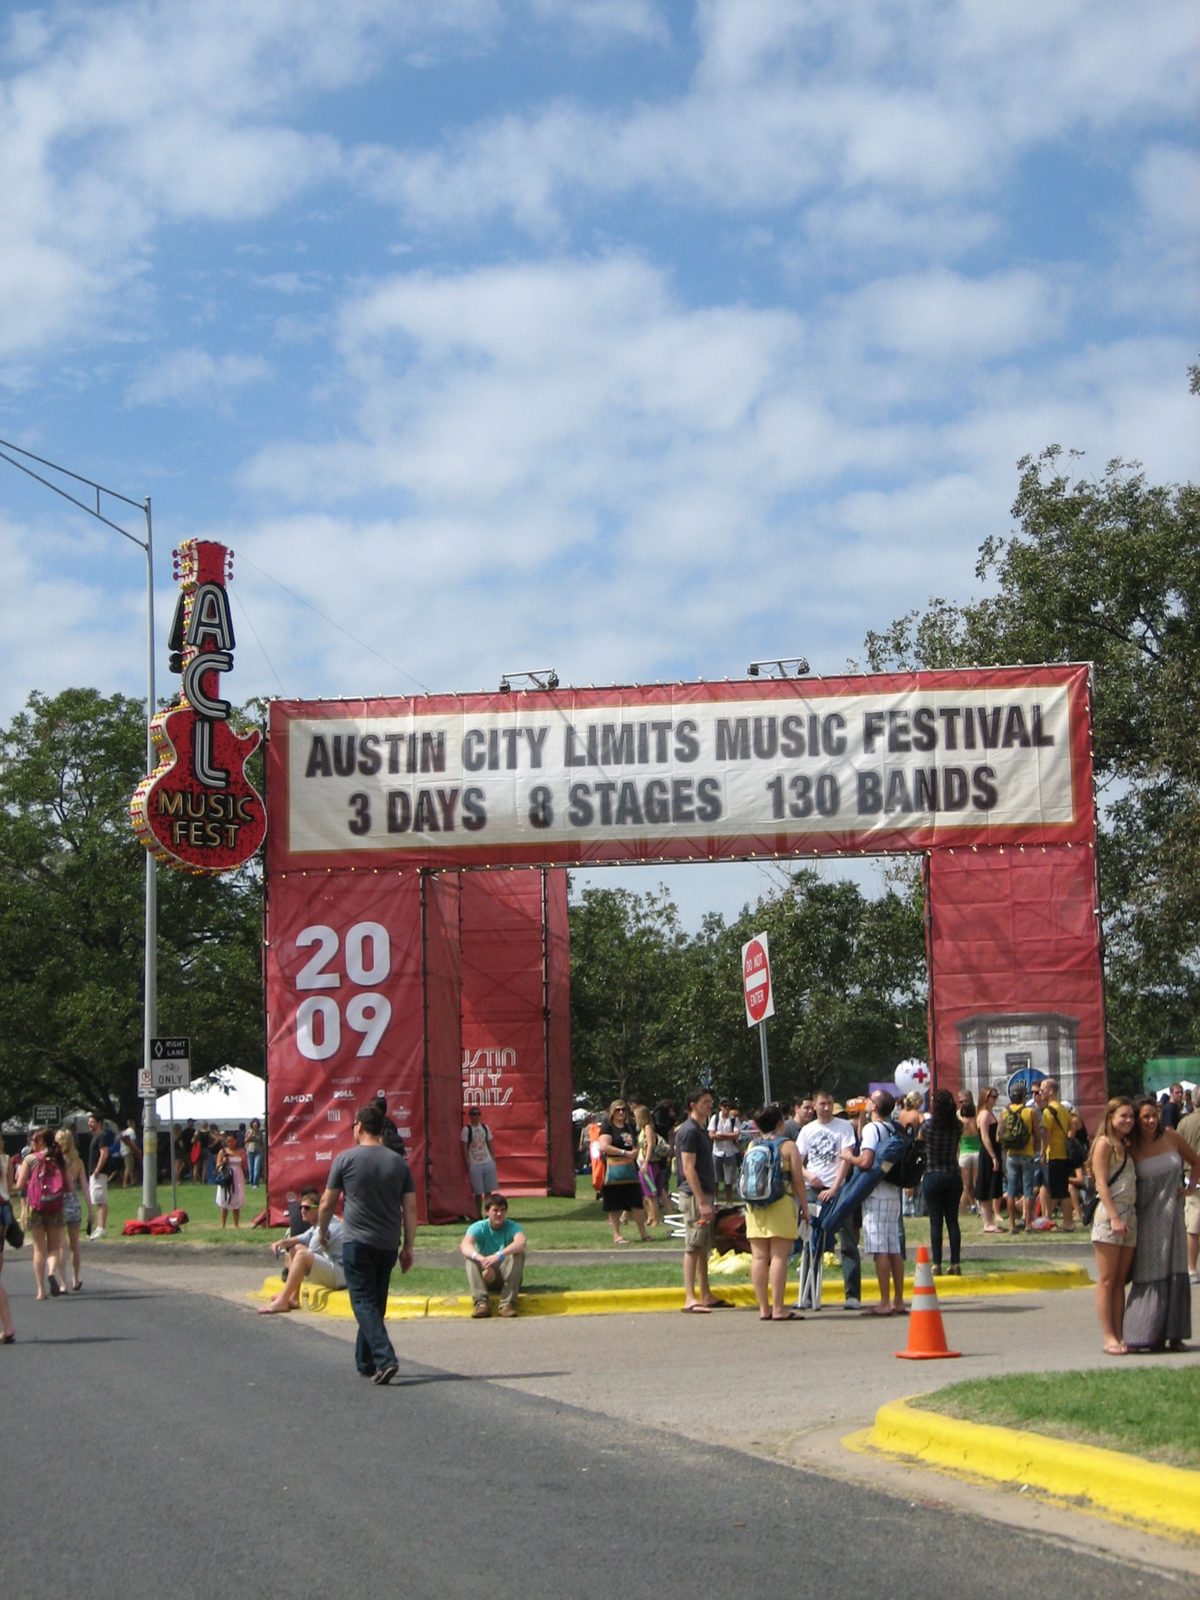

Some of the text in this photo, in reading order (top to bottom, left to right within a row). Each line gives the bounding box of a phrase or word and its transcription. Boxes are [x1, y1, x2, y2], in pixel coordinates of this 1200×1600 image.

[184, 583, 236, 788] ACL
[305, 704, 1055, 778] AUSTIN CITY LIMITS MUSIC FESTIVAL
[158, 788, 252, 820] MUSIC
[348, 766, 998, 836] 3 DAYS 8 STAGES 130 BANDS
[172, 820, 240, 848] FEST
[296, 921, 391, 990] 20
[746, 952, 763, 973] DO NOT
[750, 989, 764, 1007] ENTER
[296, 992, 392, 1060] 09
[165, 1040, 186, 1048] RIGHT
[166, 1049, 186, 1057] LANE
[462, 1047, 517, 1068] USTIN
[158, 1074, 183, 1085] ONLY
[283, 1094, 306, 1103] AMD
[462, 1087, 513, 1106] MITS
